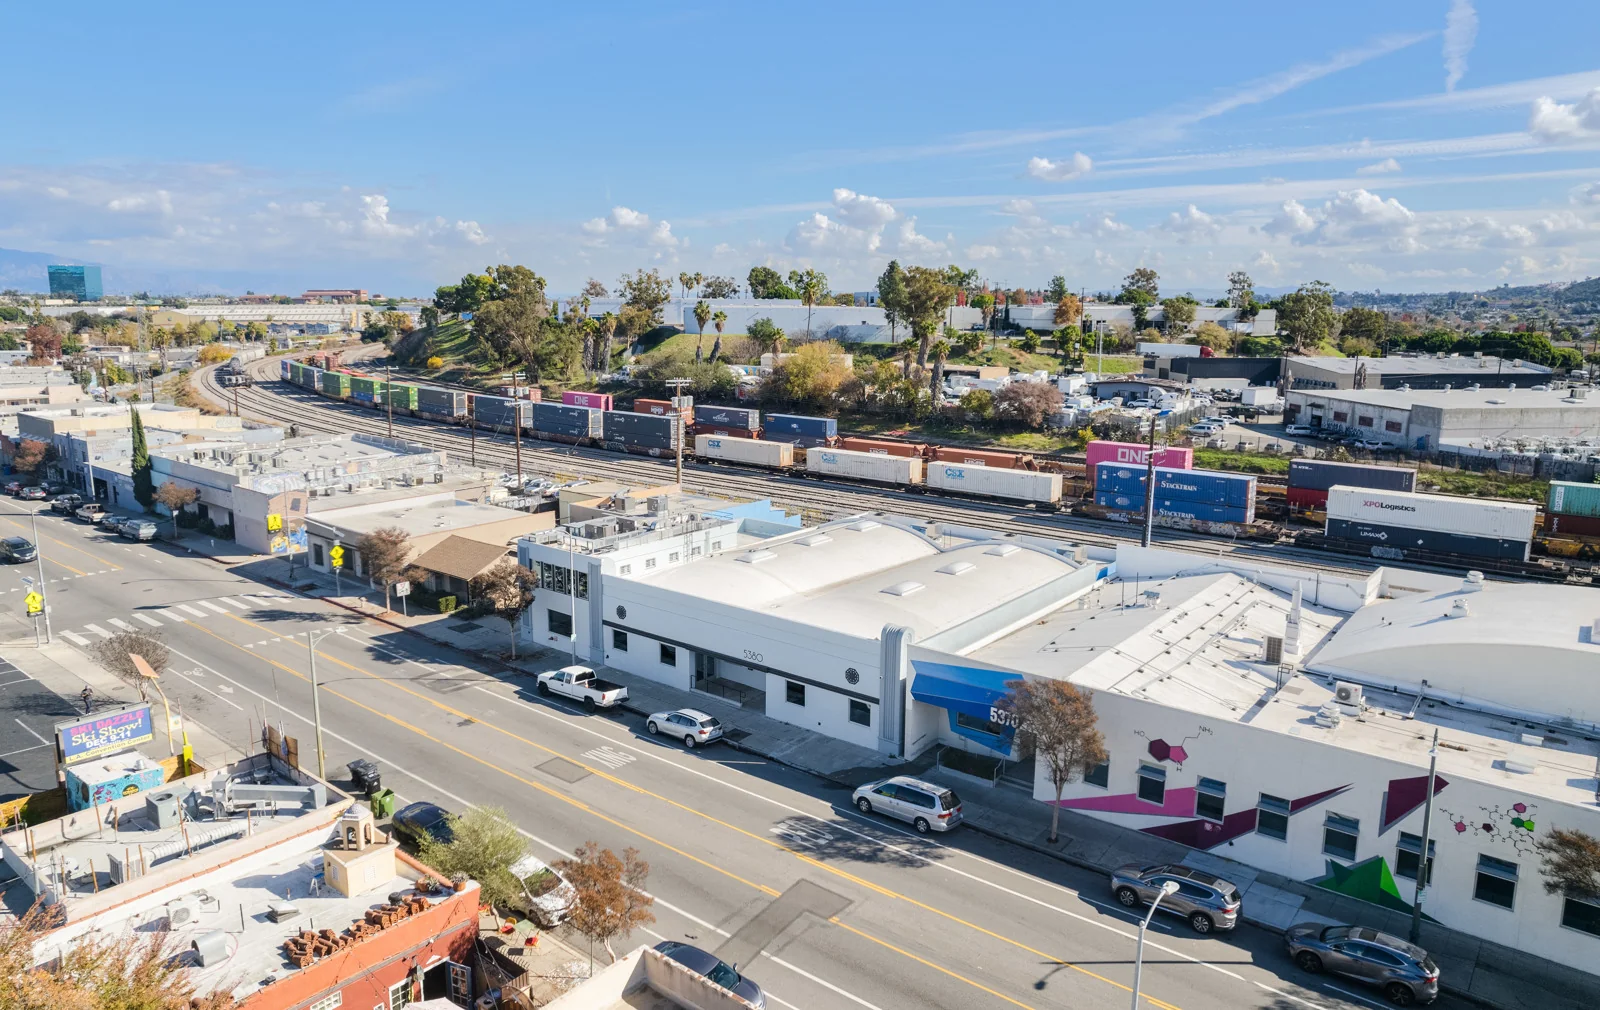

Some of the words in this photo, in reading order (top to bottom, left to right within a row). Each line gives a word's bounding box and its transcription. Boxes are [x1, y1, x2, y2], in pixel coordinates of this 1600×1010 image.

[574, 395, 589, 406] ONE
[707, 439, 721, 448] CSX
[821, 453, 838, 462] CSX
[1117, 448, 1151, 464] ONE
[945, 468, 965, 478] CSX
[743, 649, 764, 663] 5380
[70, 723, 93, 736] SKI
[96, 710, 145, 729] DAZZLE
[989, 706, 1019, 729] 5370
[71, 730, 95, 746] Ski
[98, 718, 142, 738] Show!
[1133, 729, 1146, 738] HO
[85, 738, 108, 749] DEC
[109, 730, 132, 742] 9-11
[85, 743, 126, 756] Convention
